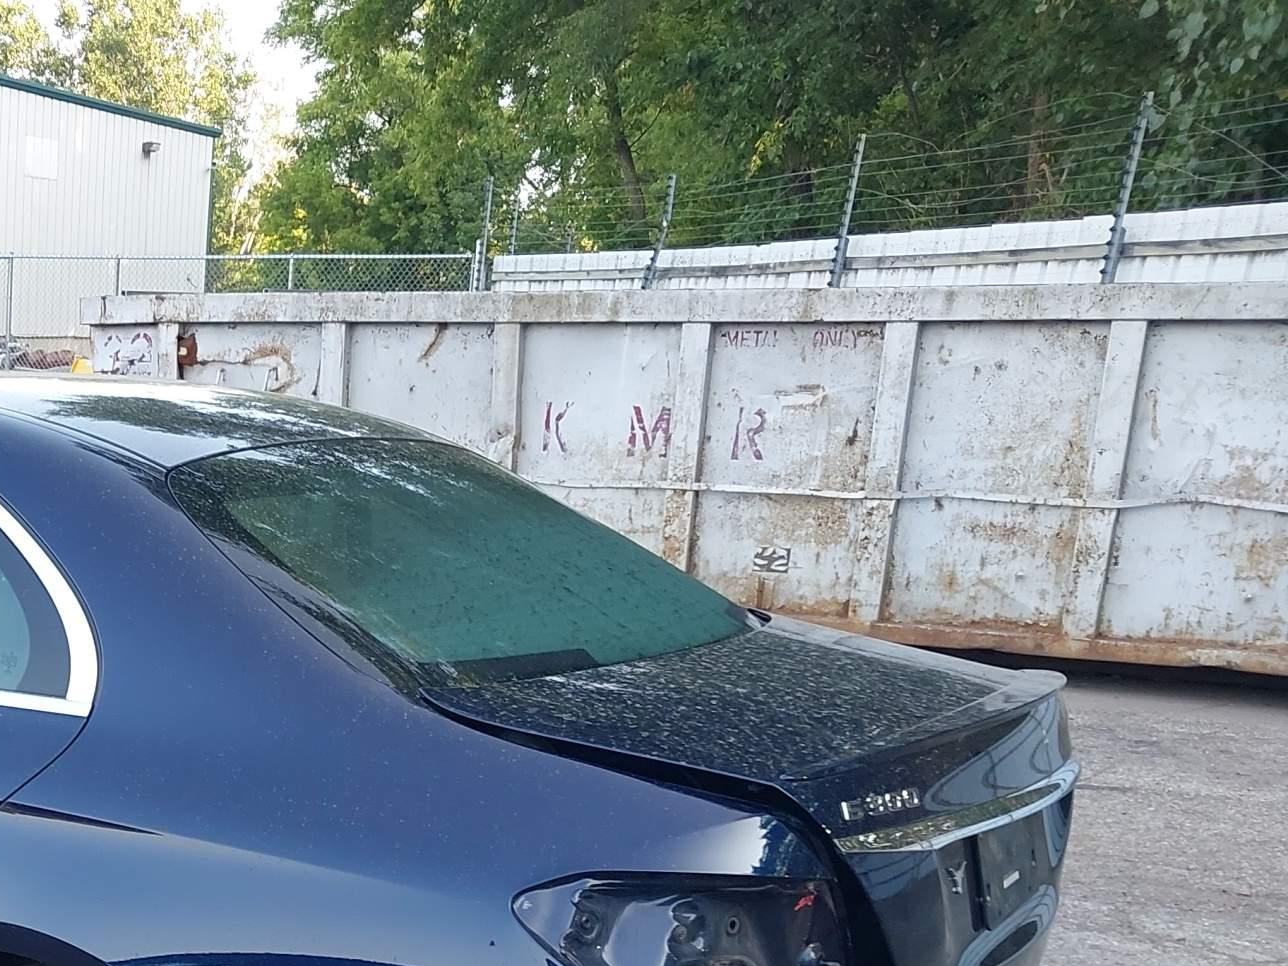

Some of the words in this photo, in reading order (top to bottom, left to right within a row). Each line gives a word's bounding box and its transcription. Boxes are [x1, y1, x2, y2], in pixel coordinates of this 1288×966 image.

[813, 328, 858, 350] ONLY
[542, 401, 574, 452] K
[626, 404, 672, 458] M
[730, 406, 767, 460] R
